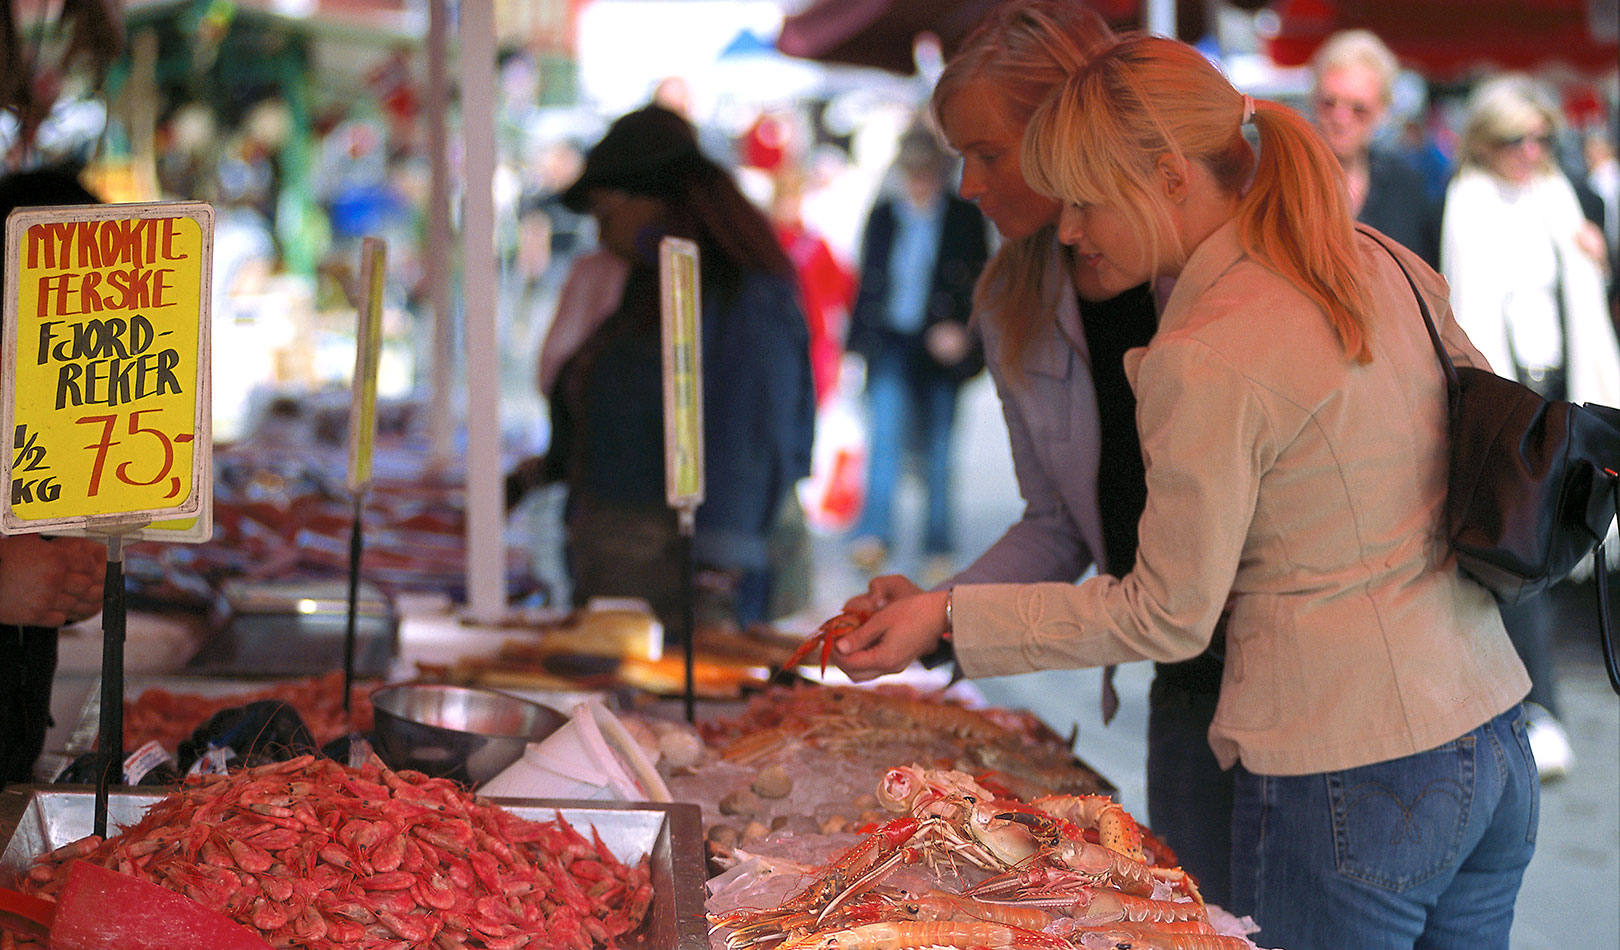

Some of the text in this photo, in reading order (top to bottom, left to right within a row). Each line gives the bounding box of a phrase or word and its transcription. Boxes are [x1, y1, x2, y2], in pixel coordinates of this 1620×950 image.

[37, 268, 177, 317] FERSKE
[37, 314, 174, 365] FJORD-
[55, 348, 182, 410] REKER
[11, 475, 62, 506] KG
